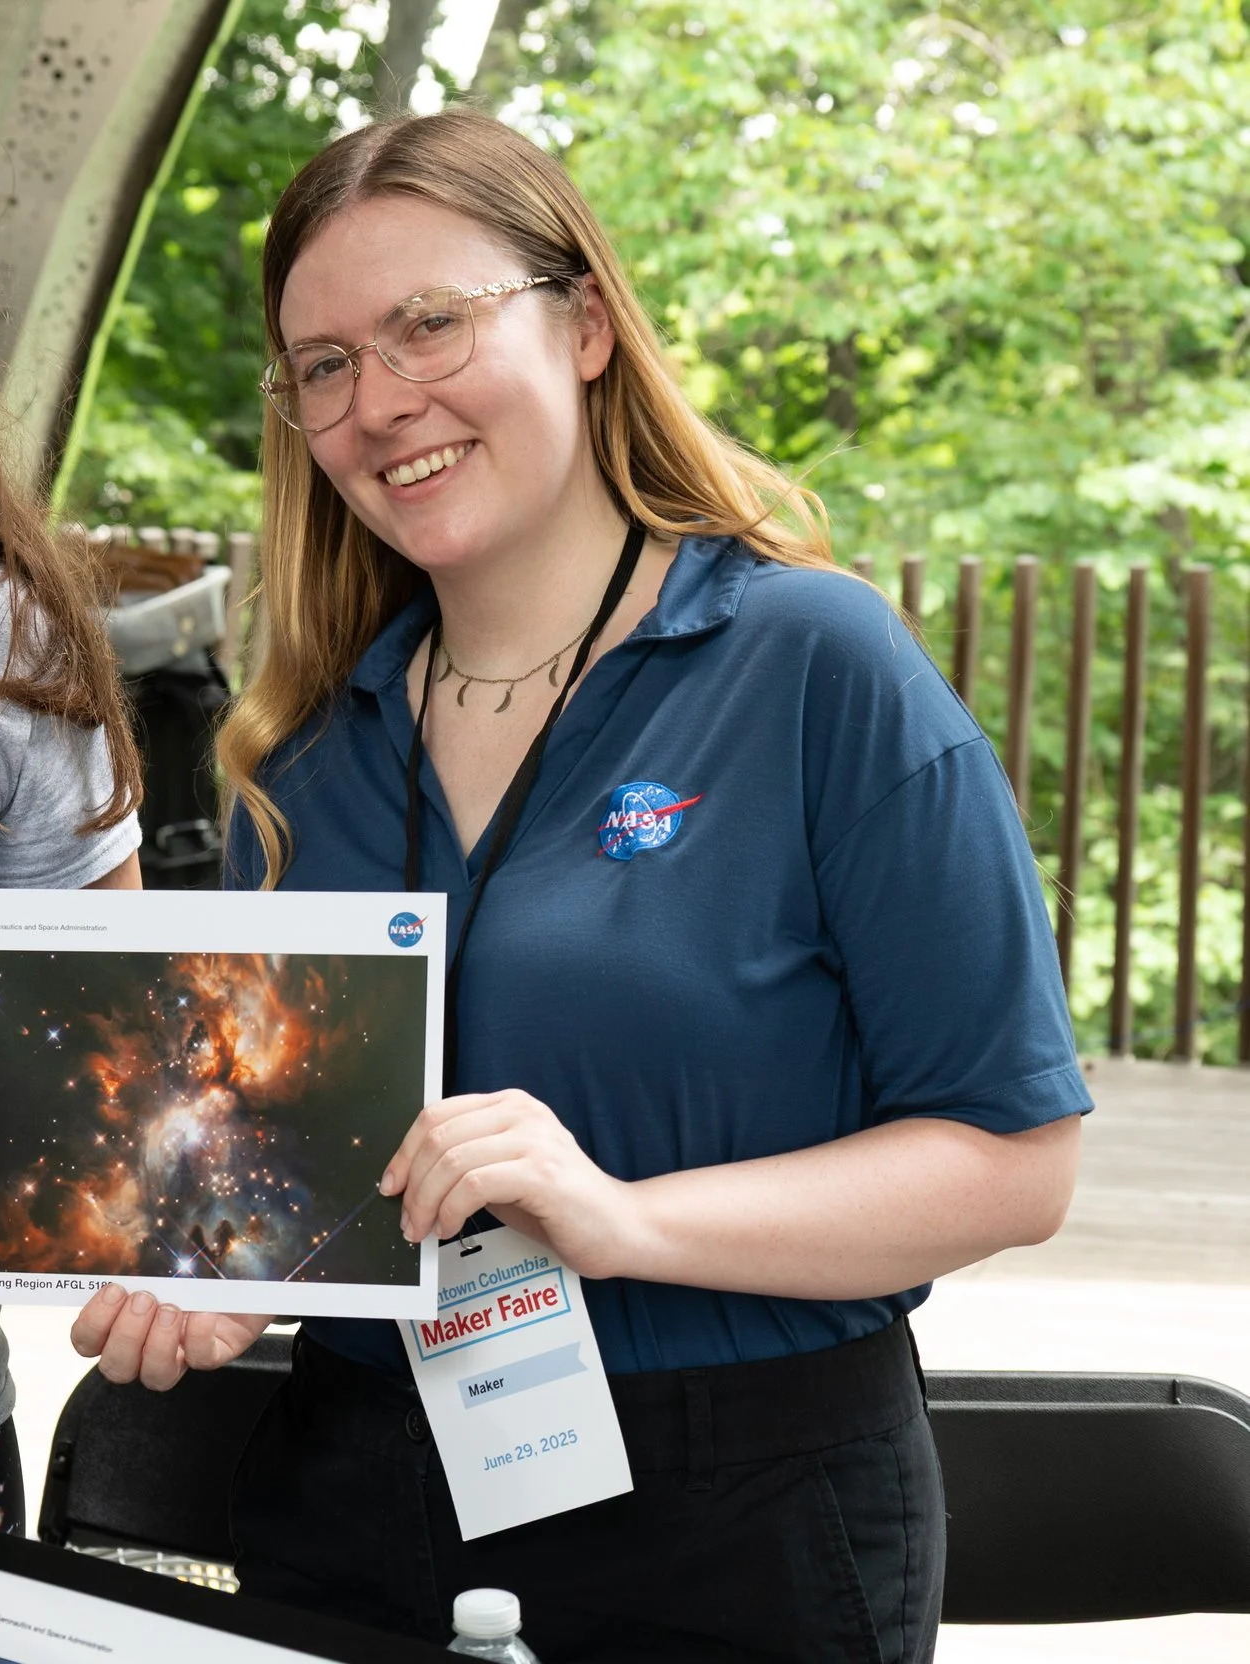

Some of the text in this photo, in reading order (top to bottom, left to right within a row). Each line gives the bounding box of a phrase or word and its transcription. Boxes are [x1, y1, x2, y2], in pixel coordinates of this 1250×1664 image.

[605, 811, 671, 833] NASA
[38, 924, 59, 932] Space
[60, 924, 108, 932] Administration
[390, 925, 422, 935] NASA
[478, 1256, 550, 1288] Columbia
[15, 1278, 53, 1290] Region
[55, 1280, 85, 1290] AFGL
[88, 1280, 113, 1290] 518
[420, 1307, 493, 1348] Maker
[468, 1377, 505, 1398] Maker
[484, 1429, 578, 1471] June 29, 2025
